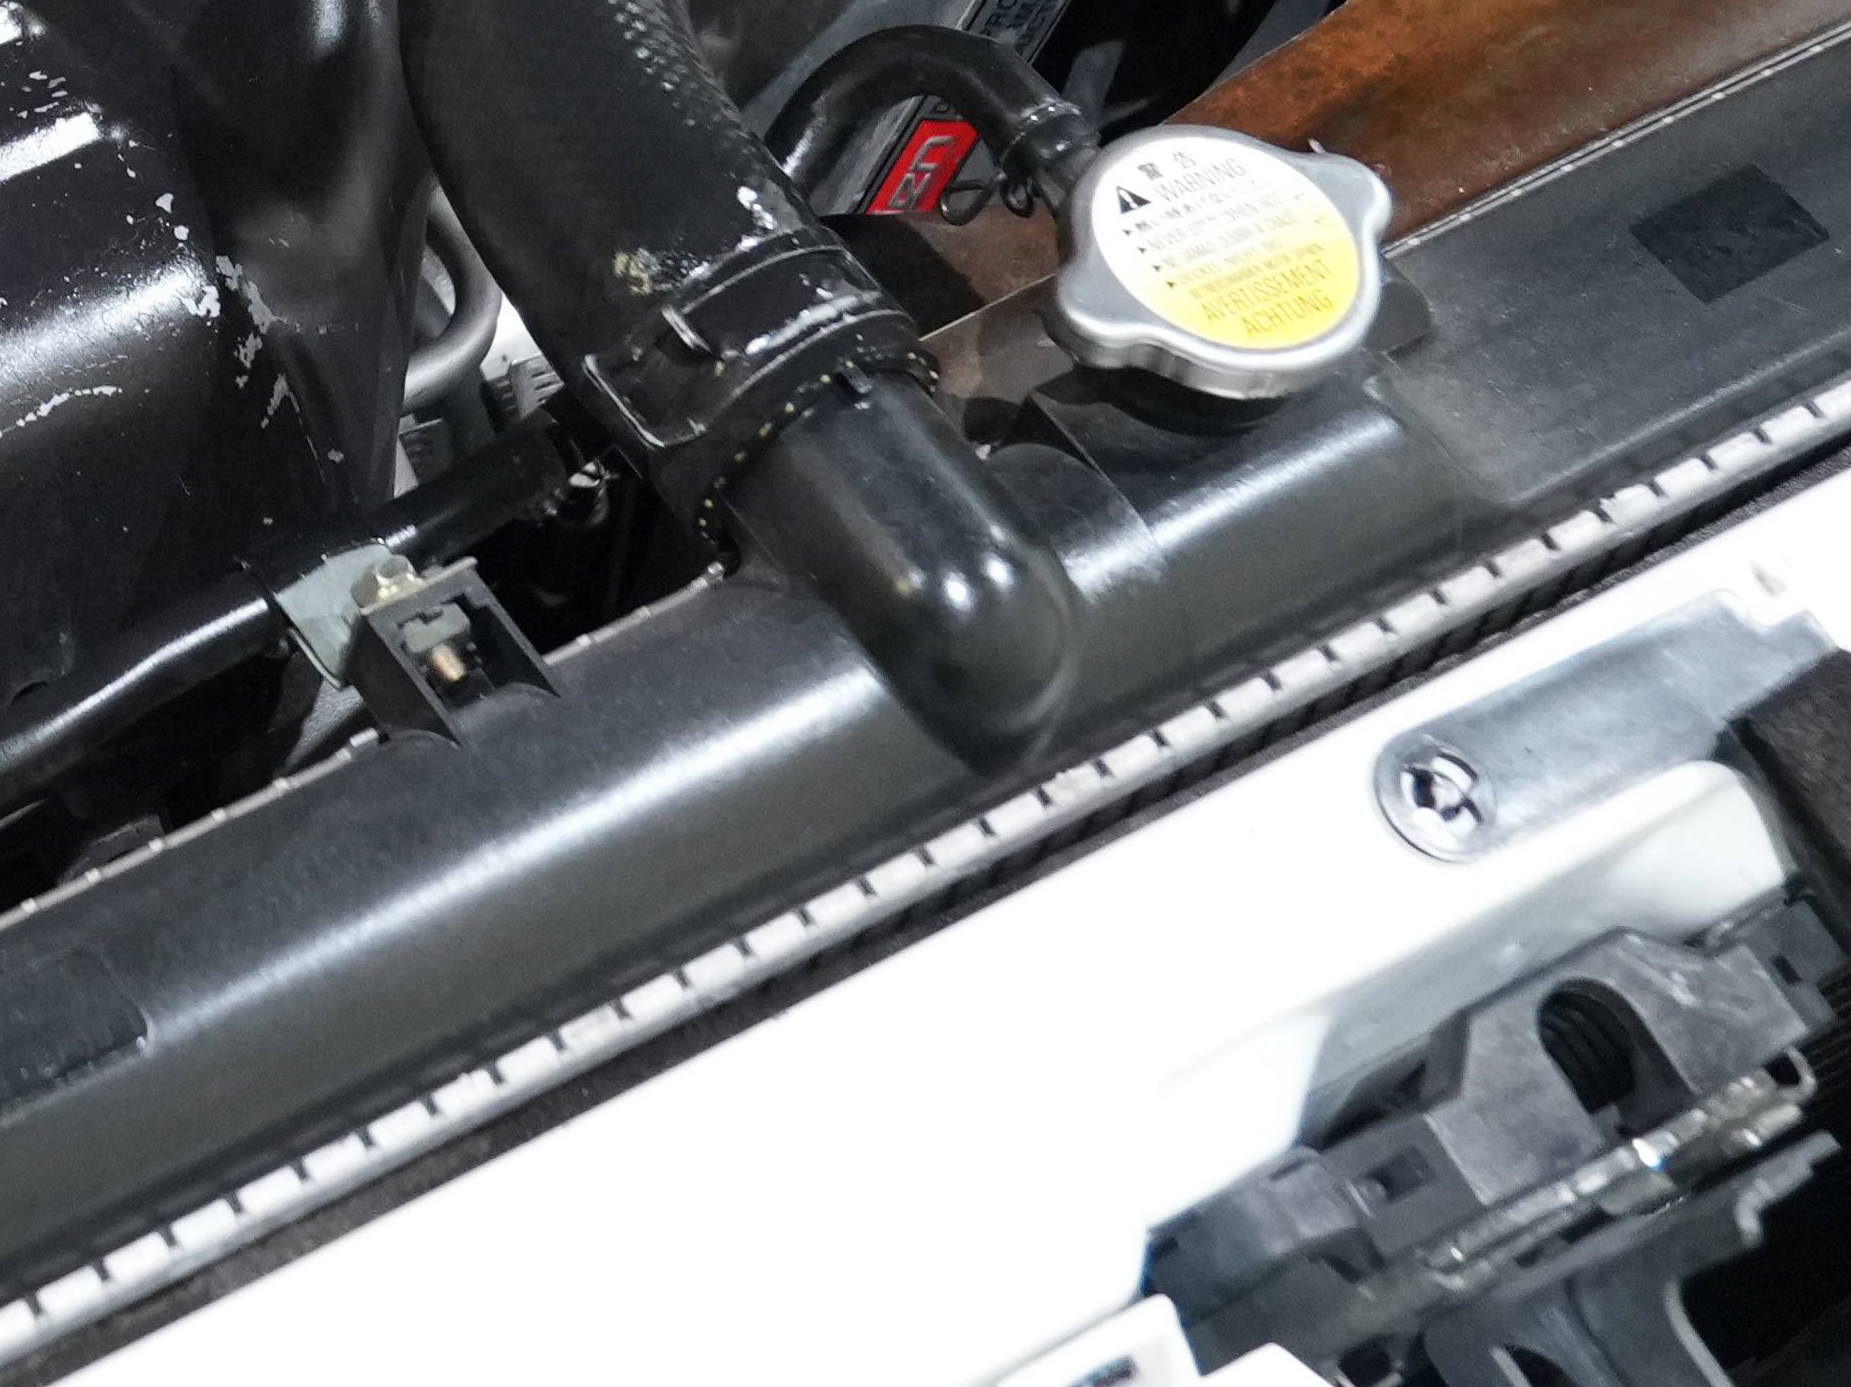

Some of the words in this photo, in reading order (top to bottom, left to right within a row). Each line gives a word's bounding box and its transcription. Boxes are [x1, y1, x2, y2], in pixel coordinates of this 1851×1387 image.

[1154, 157, 1247, 204] WARNING
[1199, 258, 1333, 324] AVERTISSEMENT
[1239, 287, 1336, 339] ACHTUNG
